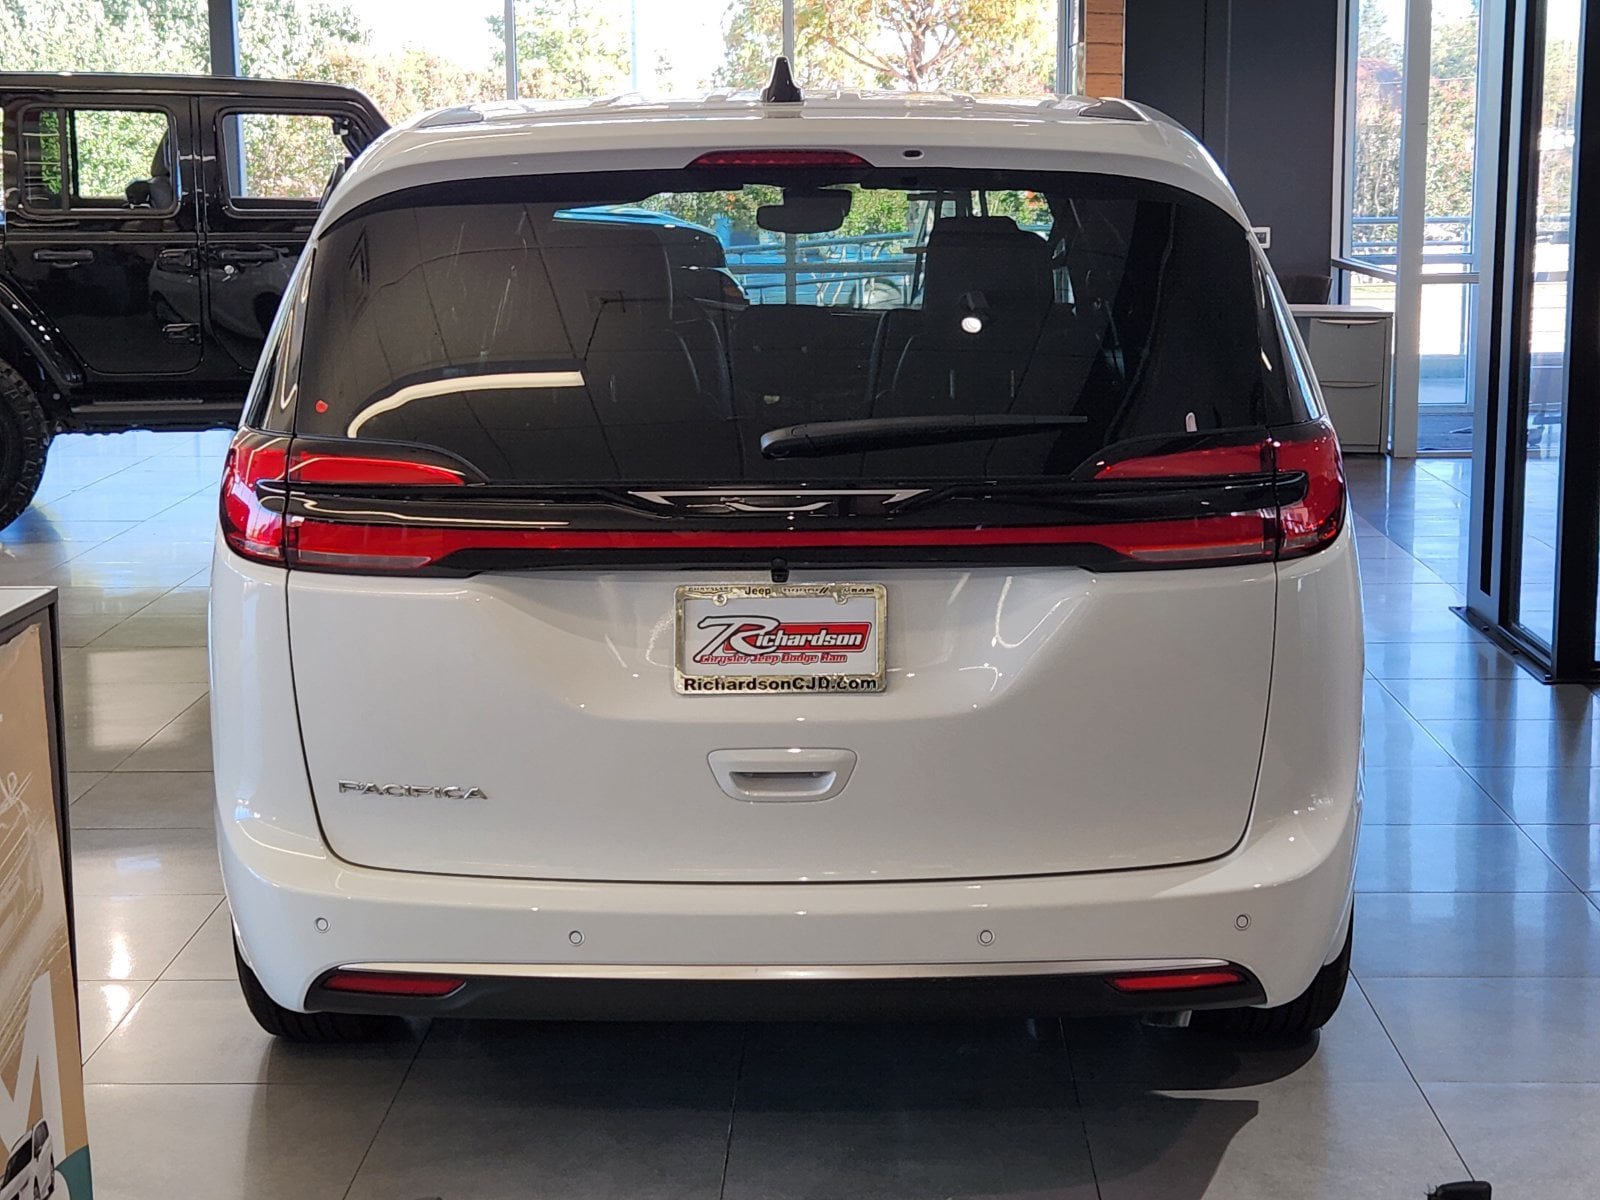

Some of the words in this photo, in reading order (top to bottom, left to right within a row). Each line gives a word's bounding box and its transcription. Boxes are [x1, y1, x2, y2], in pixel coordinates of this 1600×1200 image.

[744, 585, 771, 596] Jeep
[693, 615, 864, 663] Richardson
[700, 654, 750, 666] Chrysler
[752, 654, 780, 665] Jeep
[781, 654, 818, 665] Dodge
[820, 654, 848, 664] Ram
[684, 677, 877, 691] RichardsonCJD.com
[338, 780, 488, 800] PACIFICA
